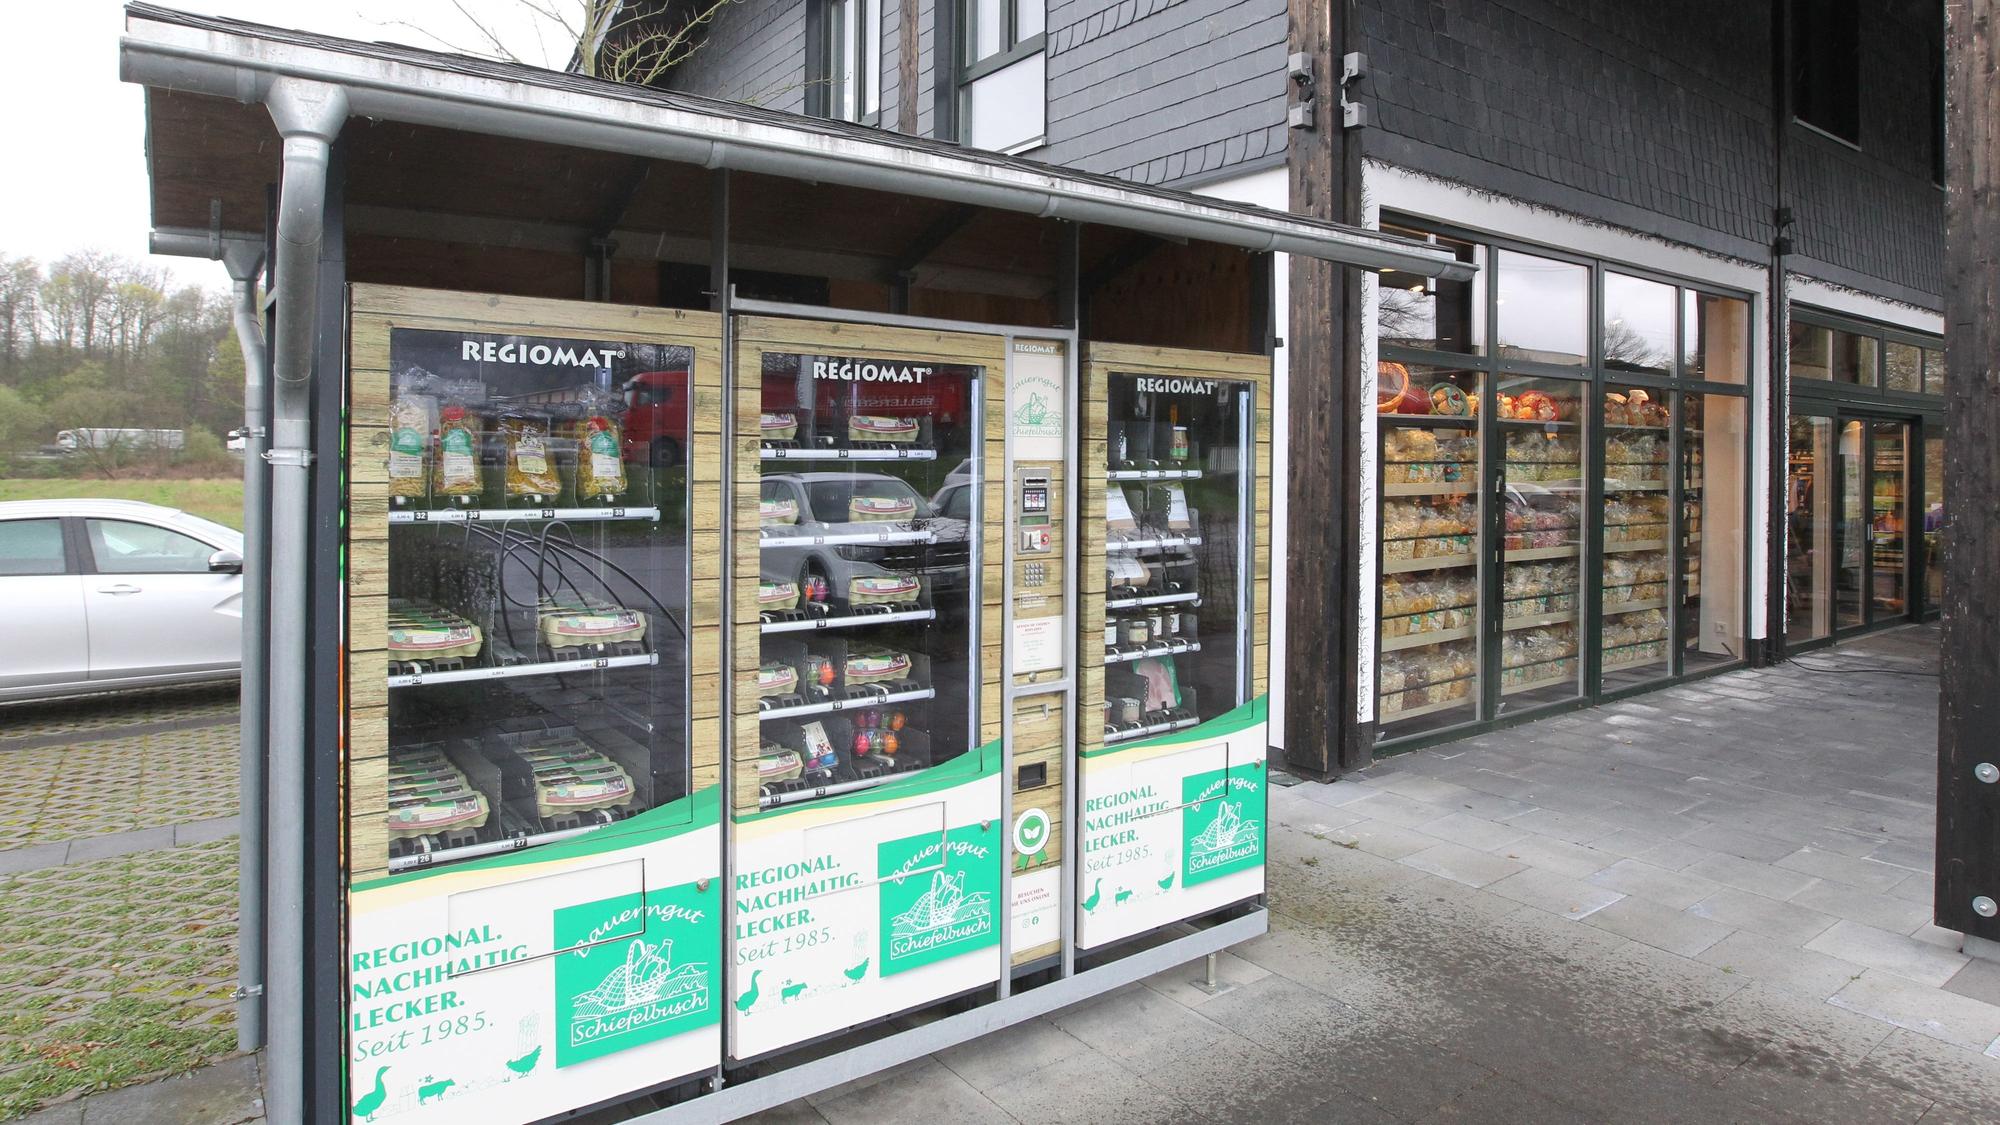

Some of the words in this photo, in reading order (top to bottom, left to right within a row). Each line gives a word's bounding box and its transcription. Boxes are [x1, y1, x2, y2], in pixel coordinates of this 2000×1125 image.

[1086, 785, 1157, 813] REGIONAL.
[1086, 830, 1139, 852] LECKER.
[1086, 854, 1114, 874] Seit
[1116, 844, 1152, 866] 1985.
[1191, 842, 1258, 871] Schiefelbusch
[736, 854, 840, 890] REGIONAL.
[736, 908, 815, 940] LECKER.
[892, 917, 988, 956] Schiefelbusch
[352, 924, 502, 972] REGIONAL.
[736, 940, 779, 966] Seit
[784, 926, 836, 954] 1985.
[353, 990, 465, 1032] LECKER.
[574, 992, 705, 1042] Schiefelbusch
[354, 1029, 414, 1062] Seit
[420, 1010, 494, 1046] 1985.
